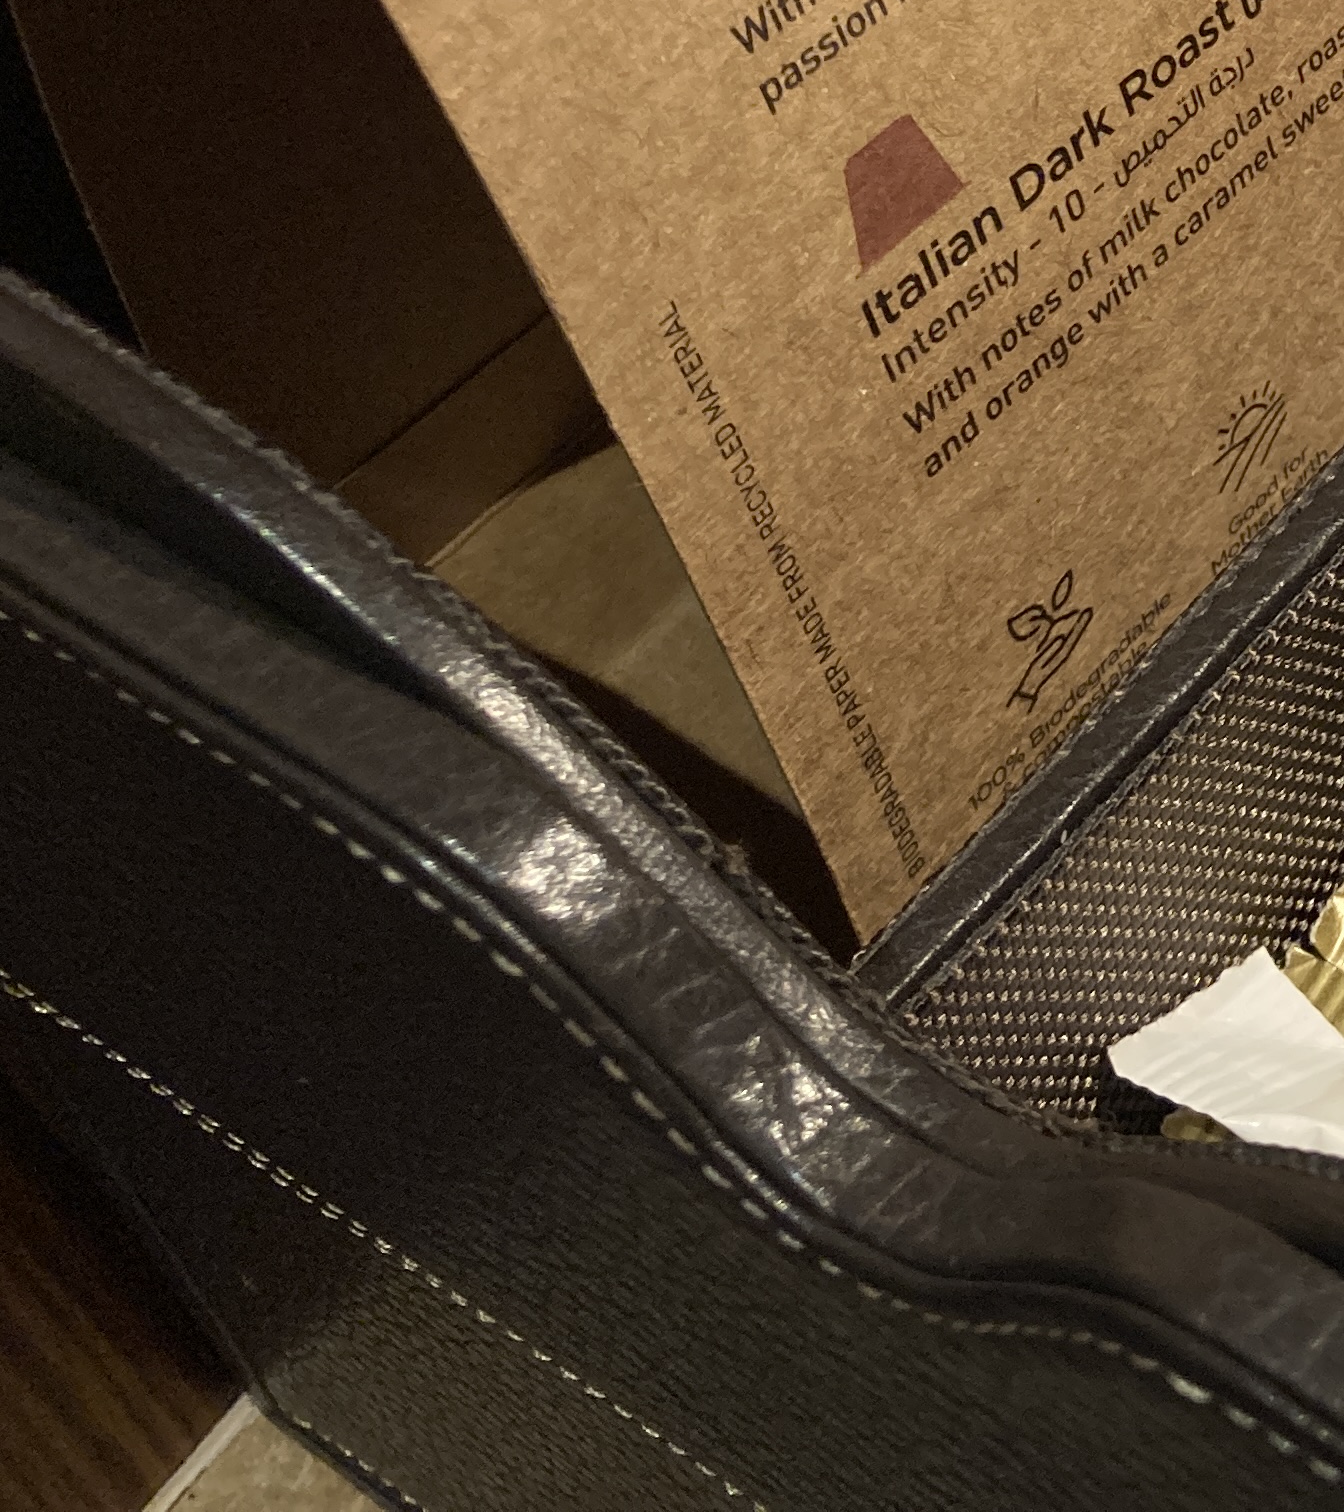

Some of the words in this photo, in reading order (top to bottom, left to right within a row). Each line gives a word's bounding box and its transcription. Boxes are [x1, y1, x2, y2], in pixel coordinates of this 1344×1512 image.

[860, 203, 1005, 337] Italian
[1009, 102, 1113, 211] Dark
[1117, 0, 1235, 118] Roast
[881, 257, 1024, 383] Intensity
[1049, 198, 1086, 232] 10
[903, 367, 977, 435] With
[982, 289, 1063, 371] notes
[1067, 252, 1098, 298] of
[1100, 196, 1161, 264] milk
[1164, 88, 1294, 205] chocolate,
[925, 418, 981, 479] and
[985, 322, 1085, 419] orange
[1089, 262, 1148, 326] with
[1154, 243, 1171, 266] a
[1174, 138, 1281, 248] caramel
[658, 299, 727, 425] MATERIAL
[715, 422, 780, 540] RECYCLED
[1211, 503, 1276, 575] Mother
[1229, 475, 1278, 534] Good
[1284, 444, 1308, 479] for
[768, 534, 809, 605] FROM
[796, 596, 836, 664] MADE
[825, 656, 866, 731] PAPER
[967, 747, 1025, 811] 100%
[1029, 593, 1171, 748] Biodegradable
[853, 723, 925, 878] BIODEGRADABLE
